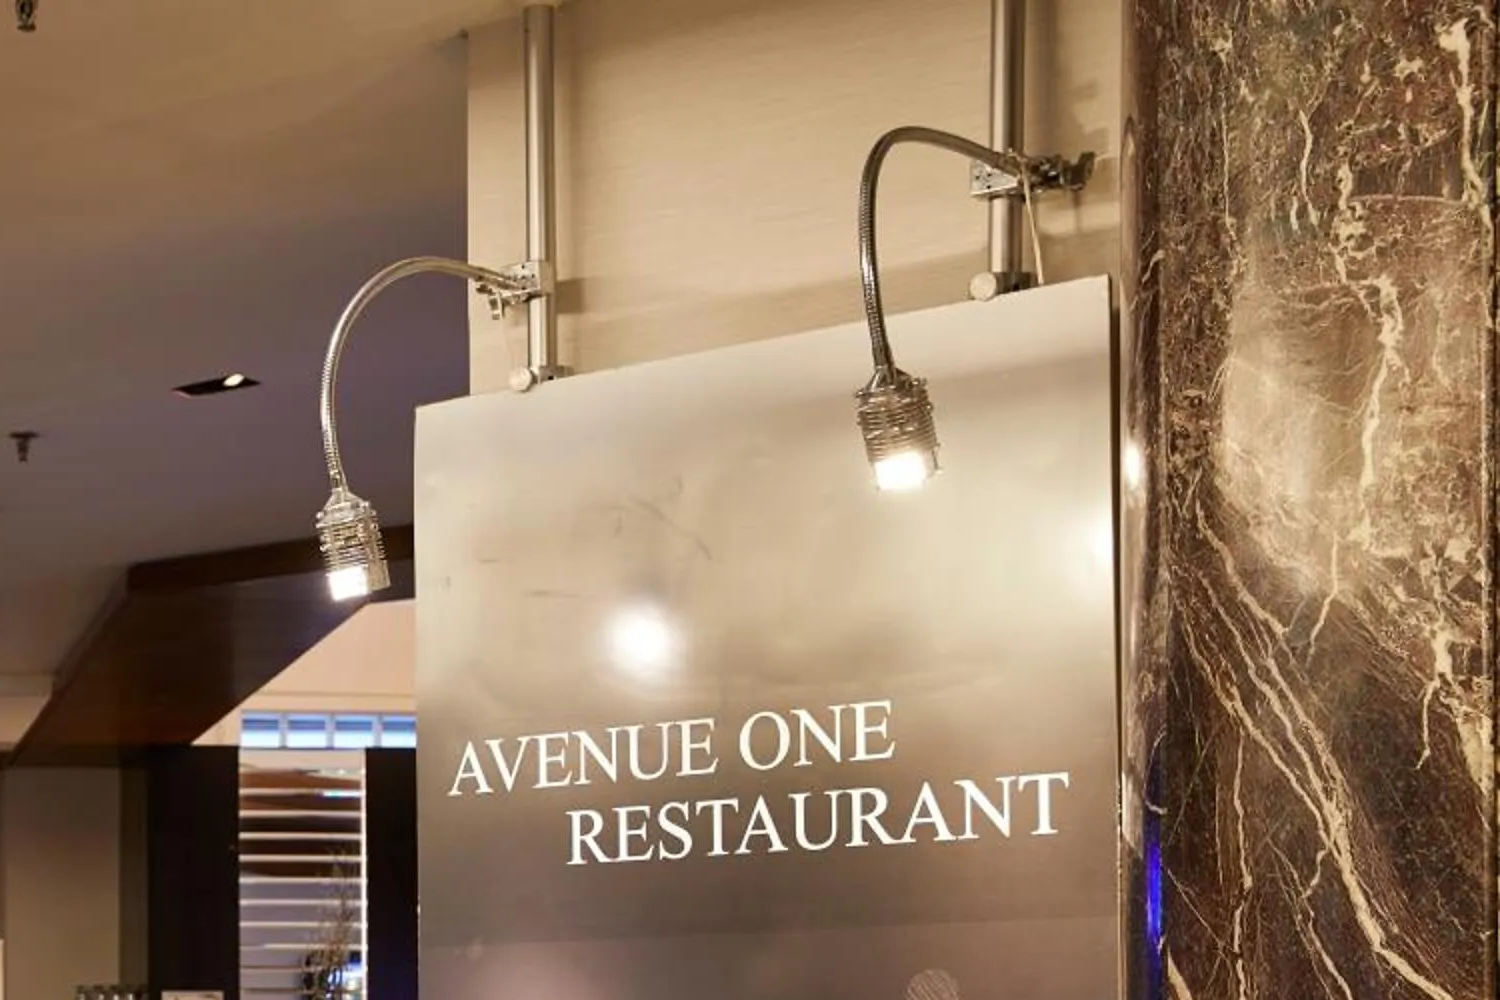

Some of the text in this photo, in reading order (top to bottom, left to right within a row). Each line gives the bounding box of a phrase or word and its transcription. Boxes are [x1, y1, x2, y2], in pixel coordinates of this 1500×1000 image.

[447, 700, 896, 797] AVENUE ONE
[566, 771, 1070, 865] RESTAURANT
